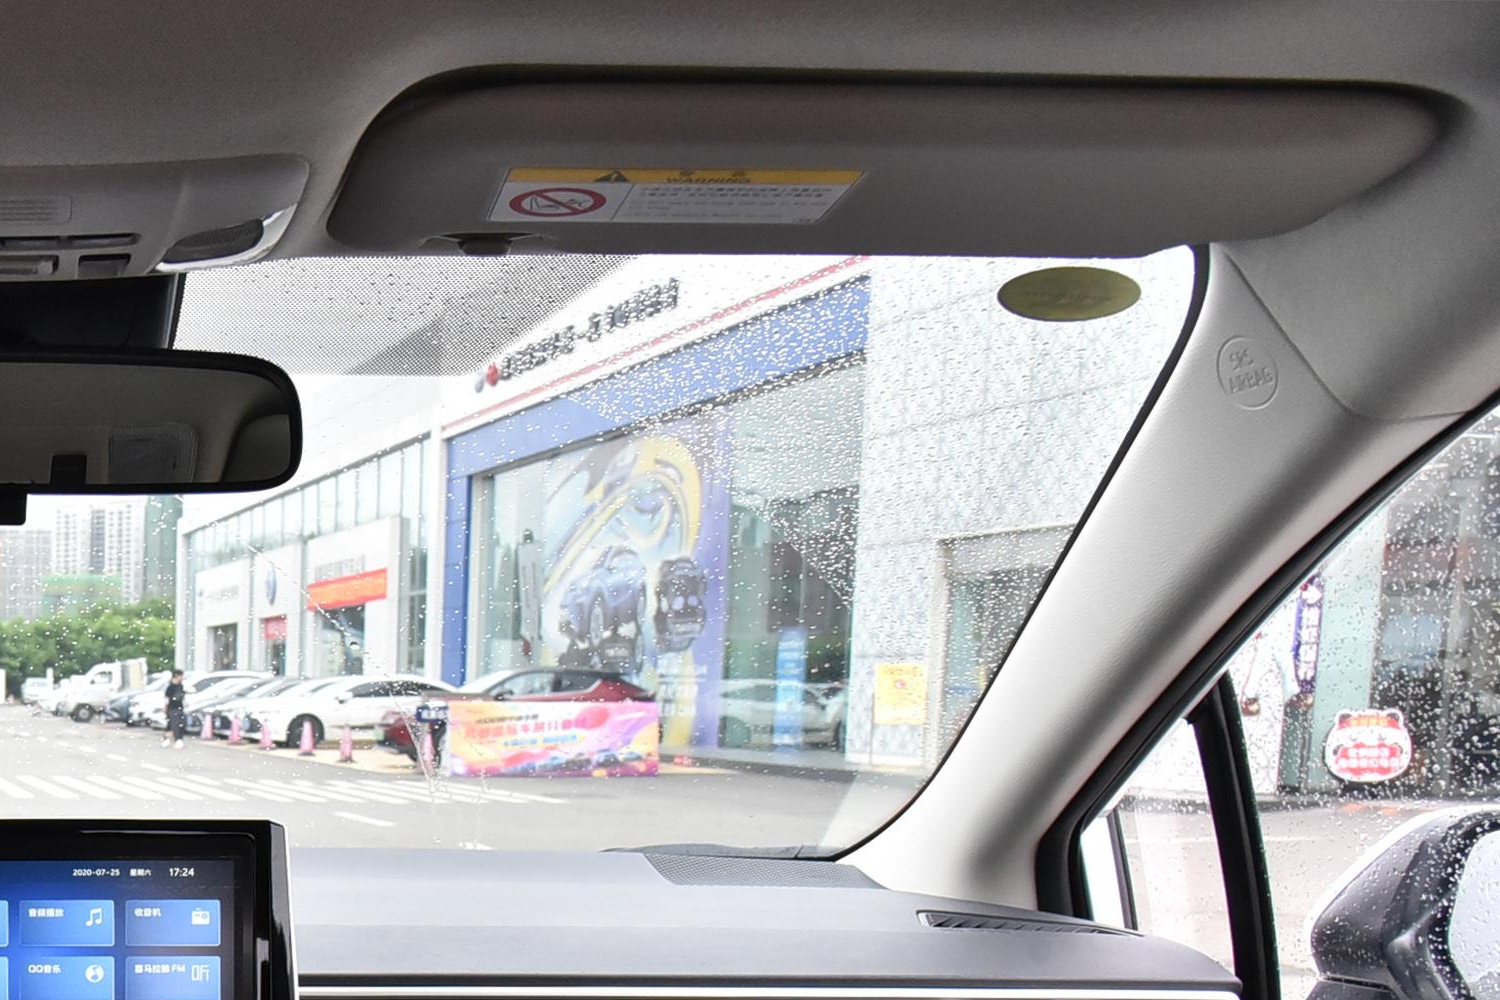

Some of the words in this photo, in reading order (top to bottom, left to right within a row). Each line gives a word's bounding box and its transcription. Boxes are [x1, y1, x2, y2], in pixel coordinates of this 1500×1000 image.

[72, 868, 120, 877] 2020-07-25
[169, 867, 195, 877] 17:24
[134, 908, 162, 918] 收音机
